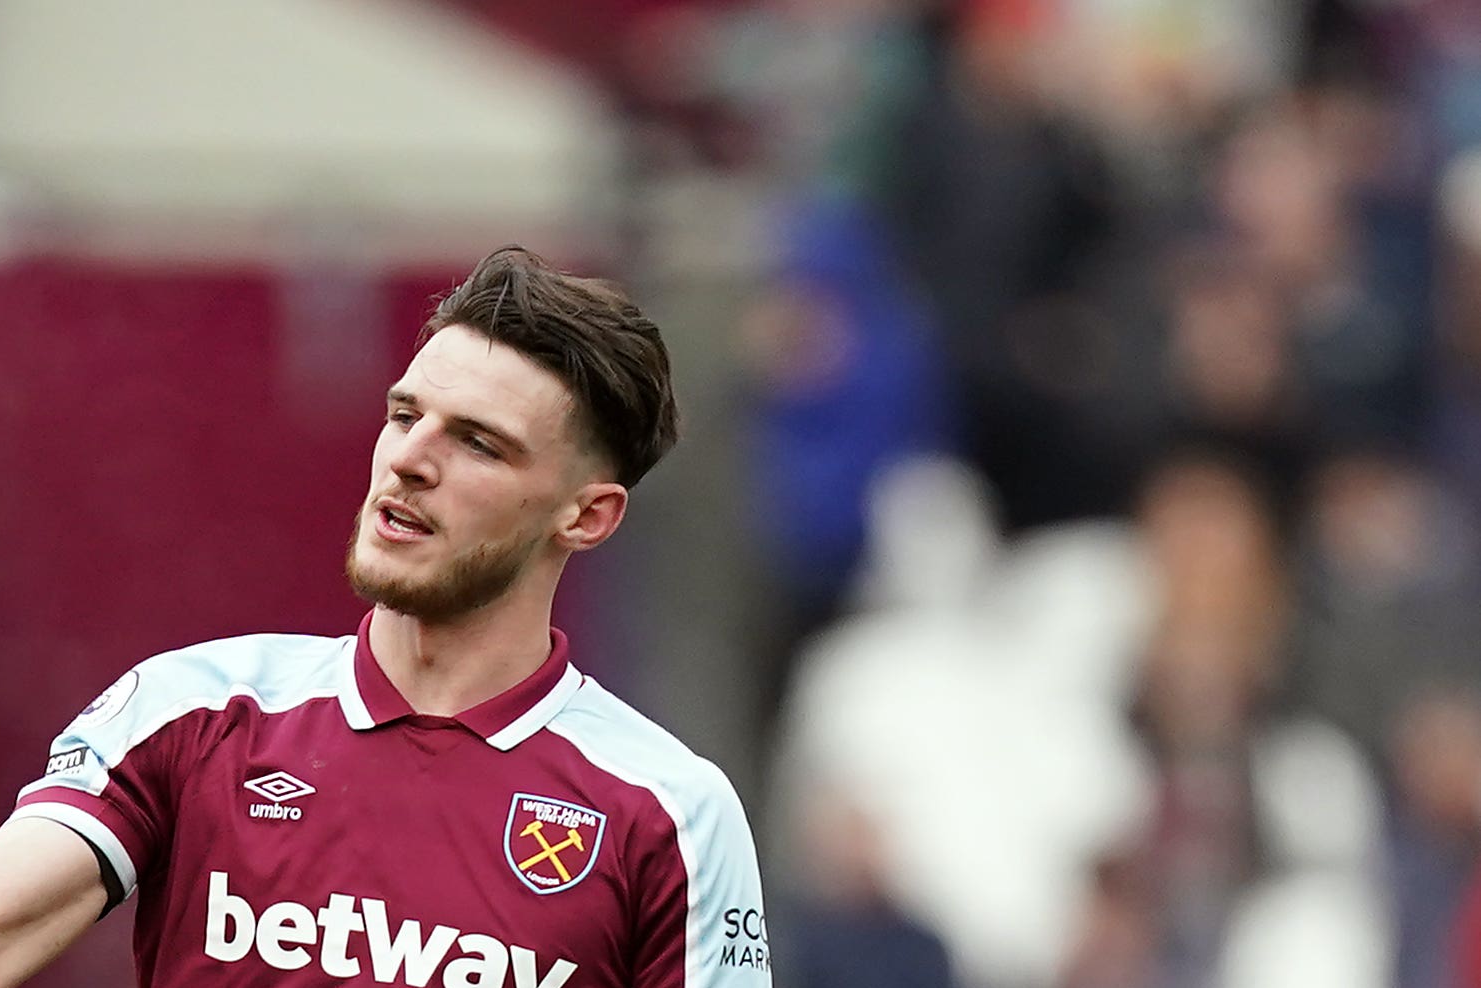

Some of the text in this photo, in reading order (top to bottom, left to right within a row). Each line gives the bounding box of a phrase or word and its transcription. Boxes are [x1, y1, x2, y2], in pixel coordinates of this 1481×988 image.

[250, 802, 302, 820] umbro
[522, 800, 596, 827] WEST HAM
